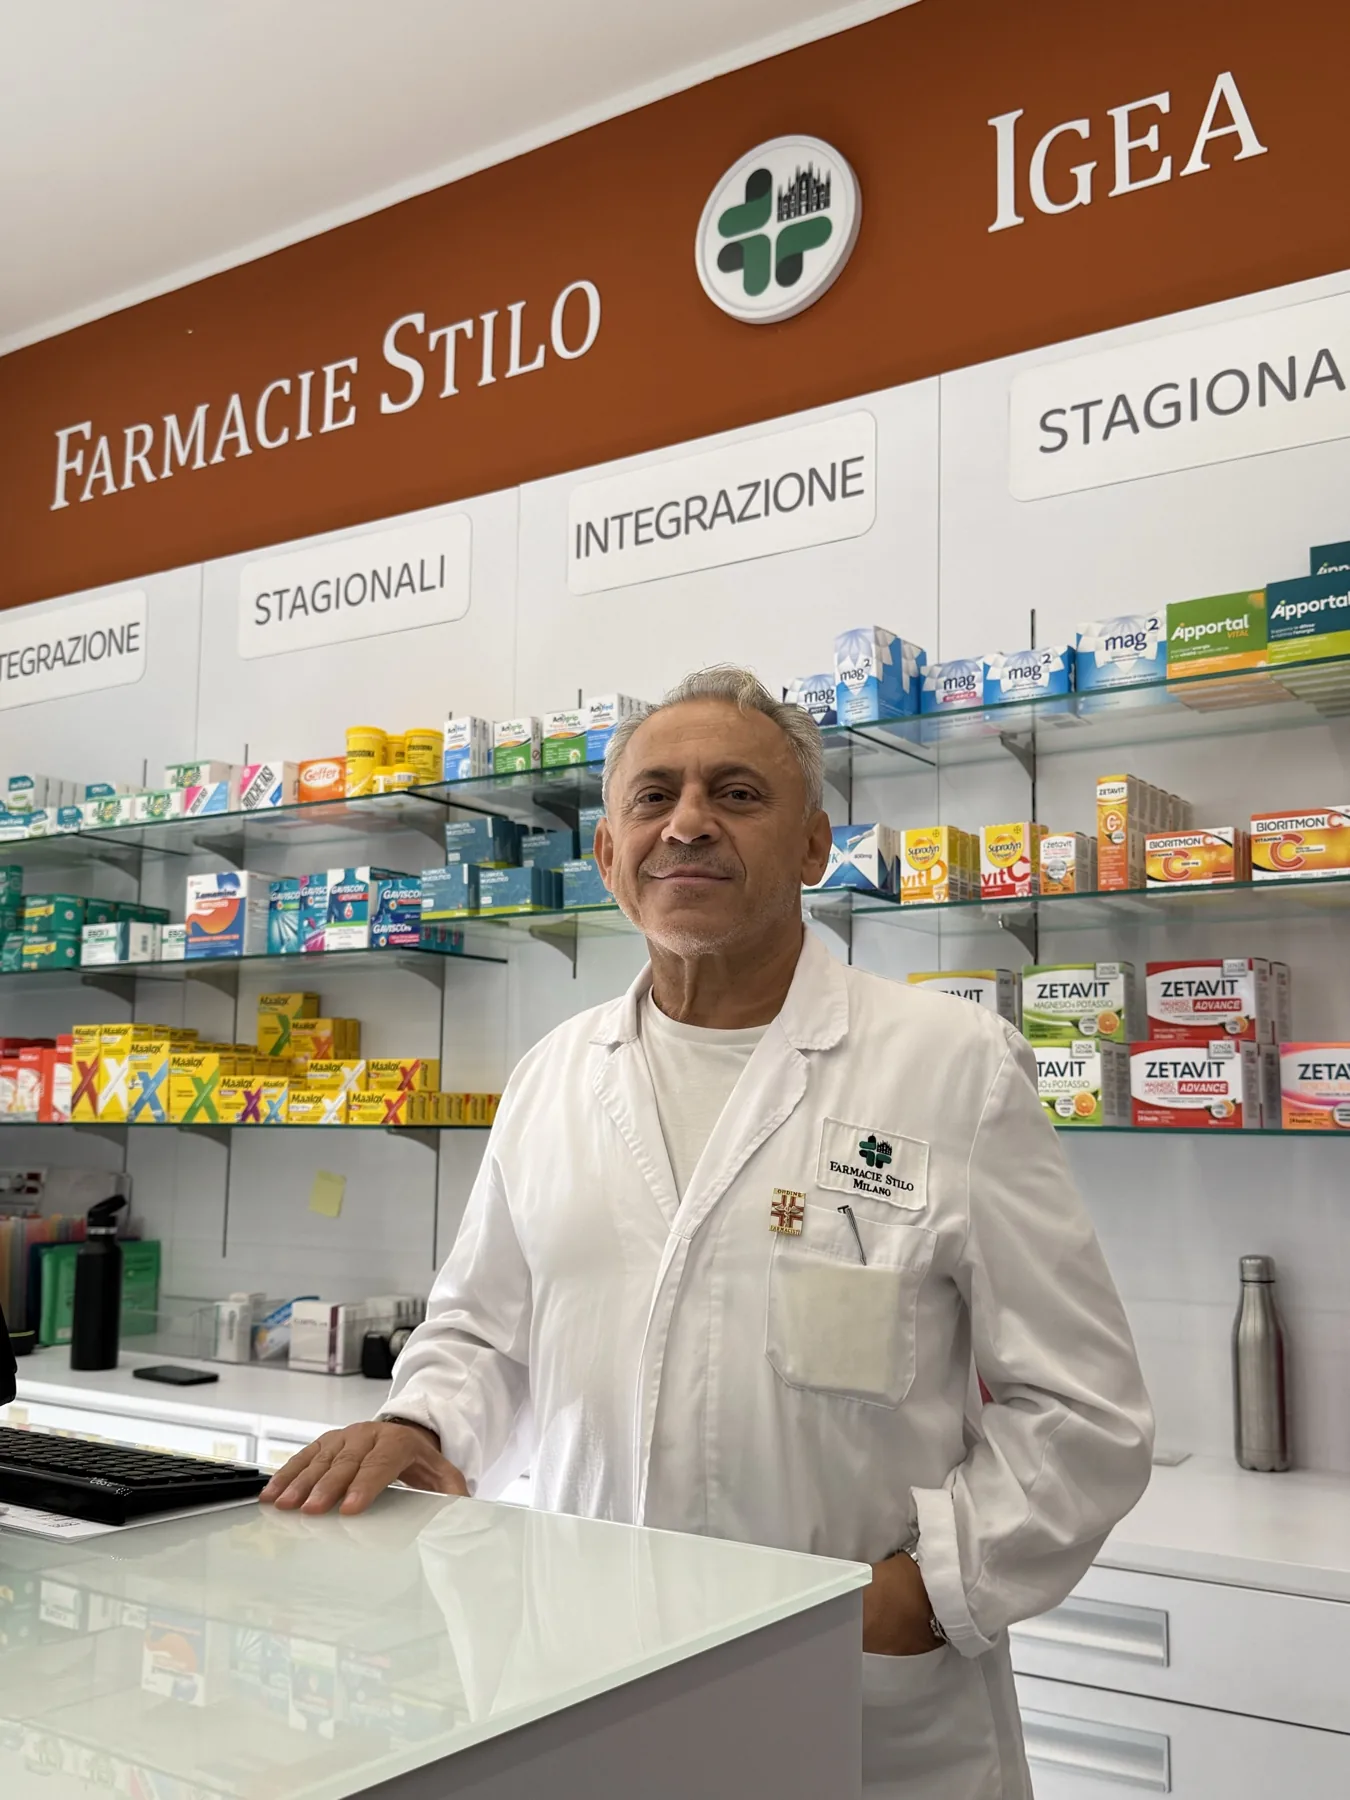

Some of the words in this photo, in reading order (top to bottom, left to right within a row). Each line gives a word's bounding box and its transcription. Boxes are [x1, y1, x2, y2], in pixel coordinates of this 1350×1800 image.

[987, 71, 1268, 233] IGEA
[50, 357, 358, 511] FARMACIE
[380, 280, 600, 414] STILO
[1039, 348, 1346, 454] STAGIONA
[575, 456, 865, 559] INTEGRAZIONE
[254, 554, 446, 626] STAGIONALI
[1170, 612, 1250, 642] Apportal
[1227, 630, 1249, 638] VITAL
[943, 674, 977, 691] mag
[804, 688, 835, 704] mag
[304, 766, 338, 783] Geffer
[1256, 817, 1325, 832] BIORITMON
[908, 843, 940, 856] Supradyn
[988, 841, 1022, 853] Supradyn
[1149, 838, 1201, 849] BIORITMON
[331, 884, 365, 894] GAVISCON
[383, 889, 422, 900] GAVISCO
[373, 923, 412, 934] GAVISCON
[1037, 982, 1110, 999] ZETAVIT
[1161, 980, 1238, 997] ZETAVIT
[260, 995, 291, 1006] Maalox
[1034, 1001, 1072, 1009] MAGNESIO
[1077, 1000, 1113, 1009] POTASSIO
[1195, 1001, 1240, 1010] ADVANCE
[103, 1027, 130, 1036] Maalox
[131, 1043, 164, 1054] Maalox
[171, 1057, 206, 1067] Maalox
[309, 1061, 344, 1072] Maalox
[371, 1061, 402, 1071] Maalox
[1146, 1062, 1225, 1078] ZETAVIT
[1298, 1063, 1350, 1080] ZETA
[221, 1078, 254, 1089] Maalox
[1180, 1083, 1227, 1092] ADVANCE
[291, 1093, 325, 1104] Maalox
[352, 1093, 385, 1104] Maalox
[830, 1161, 883, 1182] FARMACIE
[885, 1174, 914, 1192] STILO
[853, 1178, 892, 1197] MILANO
